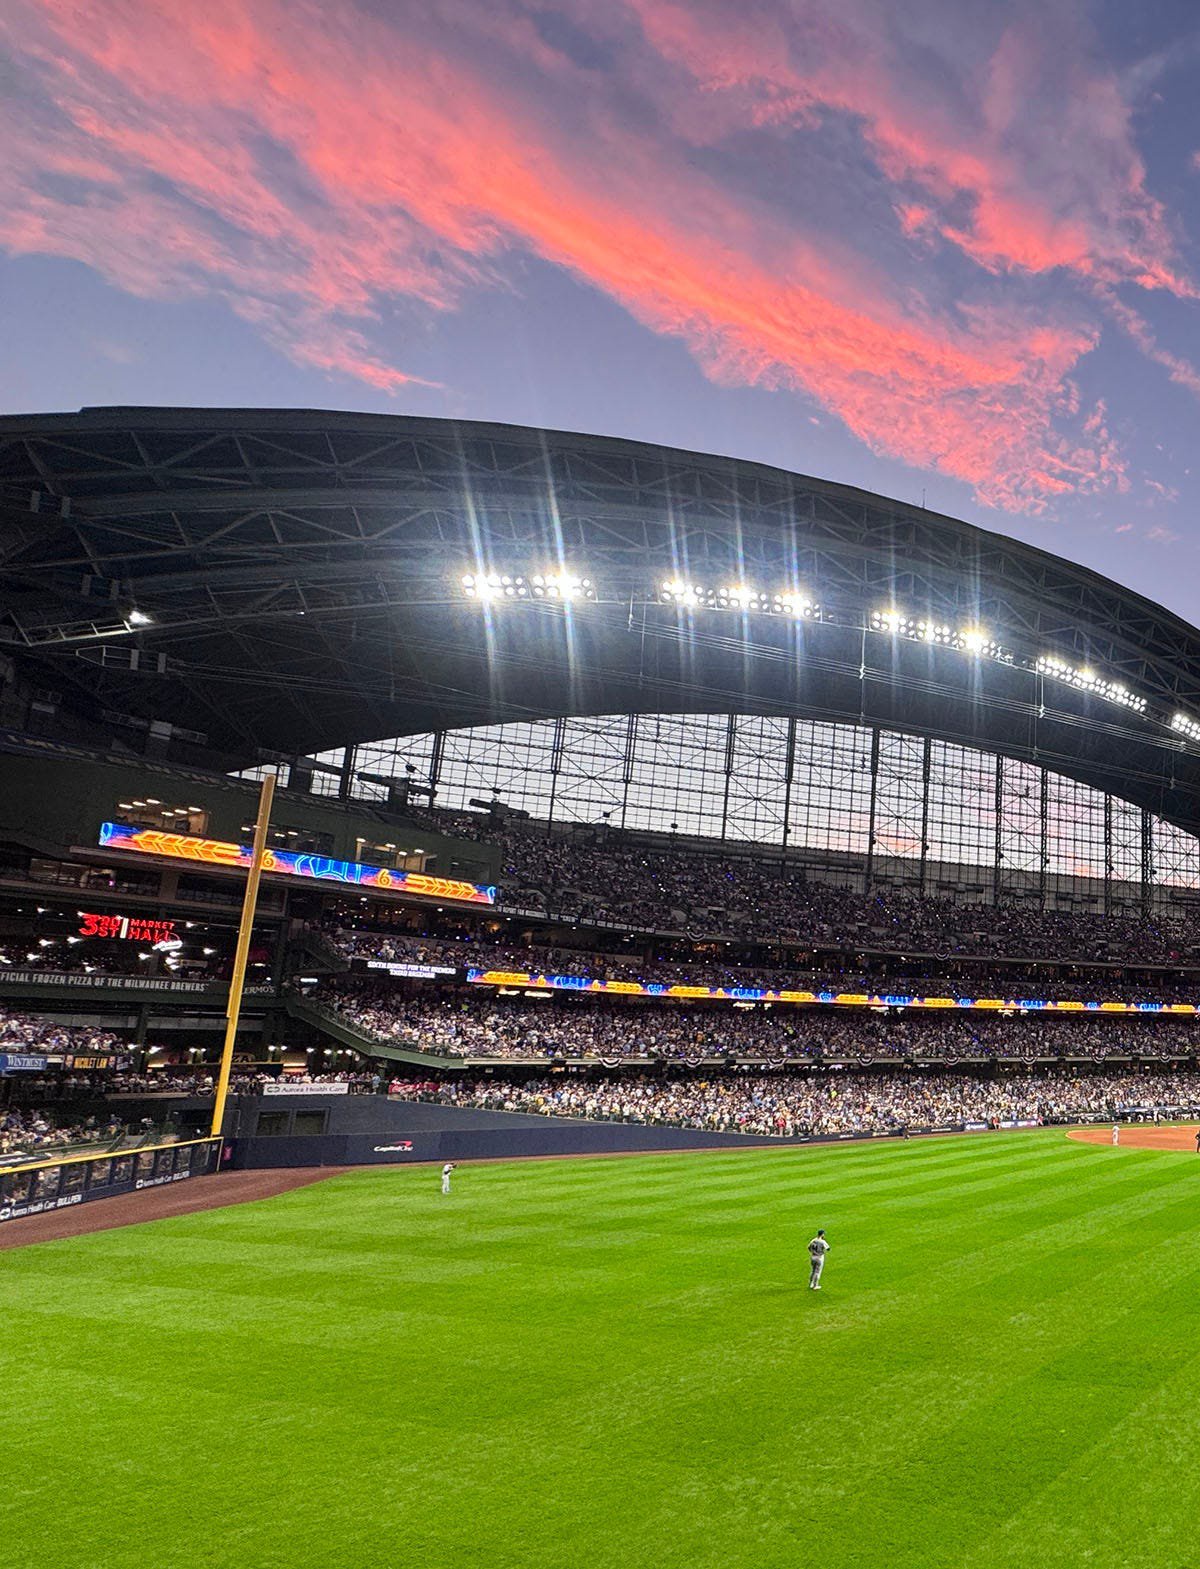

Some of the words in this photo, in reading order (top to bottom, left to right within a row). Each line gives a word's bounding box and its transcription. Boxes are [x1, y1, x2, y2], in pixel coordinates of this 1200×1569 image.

[262, 849, 276, 869] 6
[377, 868, 392, 888] 6
[130, 918, 175, 930] MARKET
[127, 927, 172, 943] HALL
[32, 973, 66, 985] FROZEN
[68, 975, 92, 986] PIZZA
[94, 977, 106, 987] OF
[107, 978, 123, 987] THE
[124, 979, 169, 990] MILWAUKEE
[243, 984, 275, 994] ERMO'S
[7, 1055, 44, 1068] WINTRUST
[305, 1085, 328, 1093] Health
[28, 1201, 43, 1213] Health
[56, 1194, 82, 1207] BULLPEN
